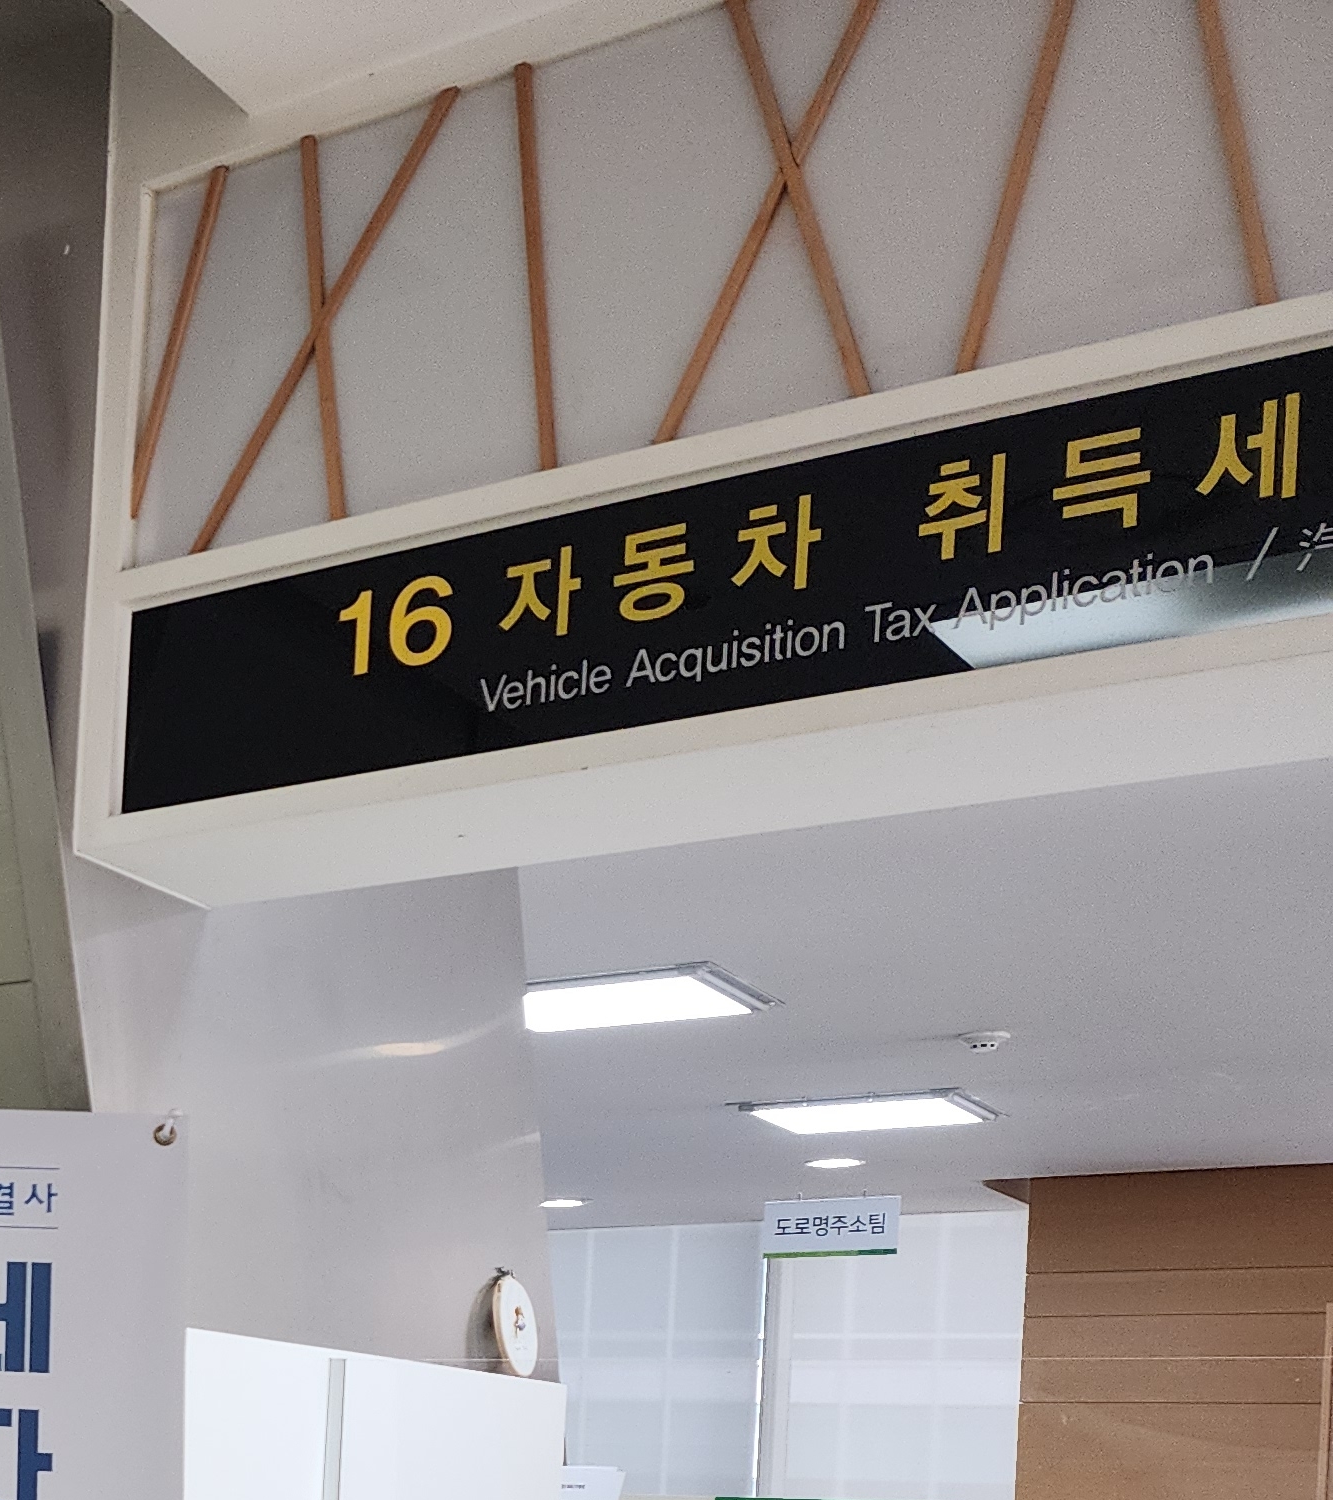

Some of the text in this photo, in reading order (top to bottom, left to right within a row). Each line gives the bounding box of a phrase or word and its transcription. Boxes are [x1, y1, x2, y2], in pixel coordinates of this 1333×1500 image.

[337, 391, 1301, 678] 16 자동차 취득세
[479, 658, 612, 715] Vehicle
[626, 608, 846, 693] Acquisition
[866, 599, 937, 647] Tax
[954, 545, 1215, 636] Application
[774, 1213, 886, 1237] 도로명주소팀
